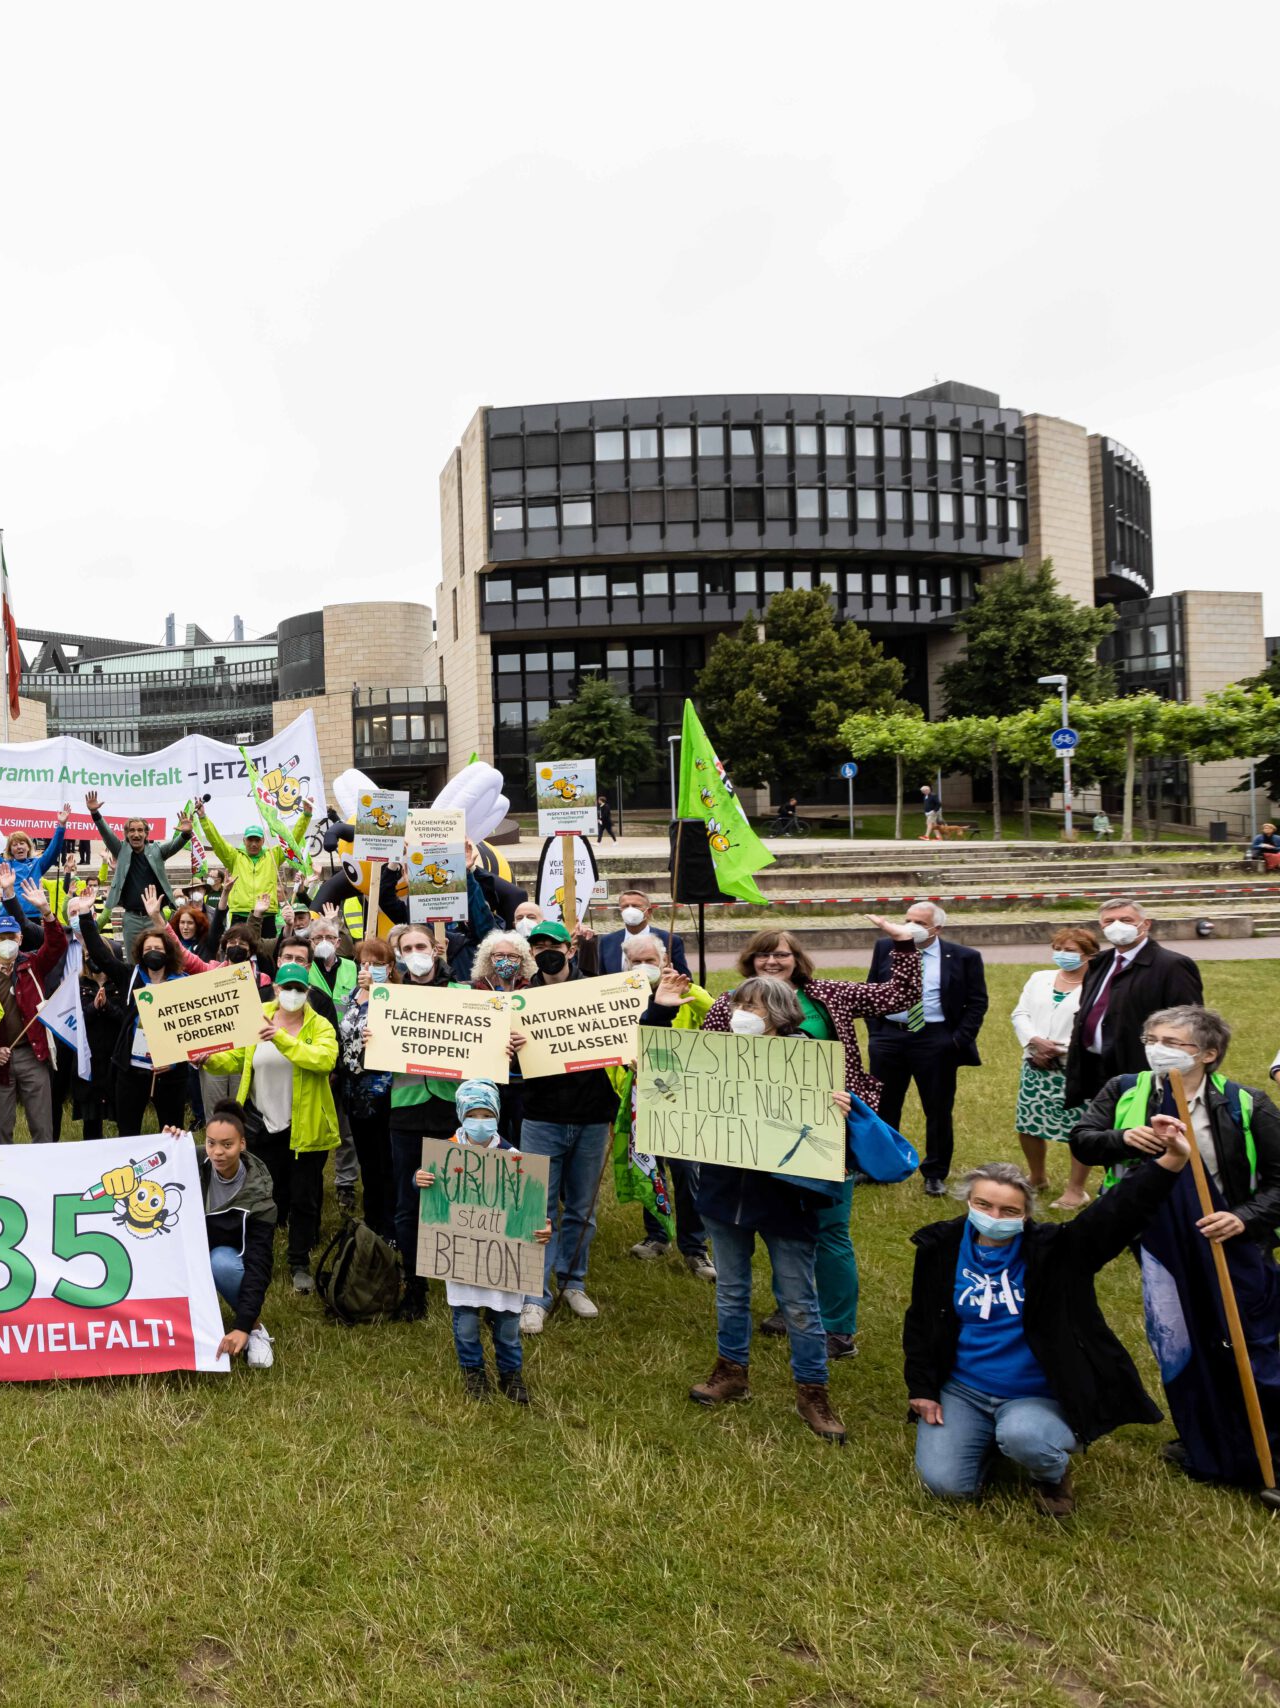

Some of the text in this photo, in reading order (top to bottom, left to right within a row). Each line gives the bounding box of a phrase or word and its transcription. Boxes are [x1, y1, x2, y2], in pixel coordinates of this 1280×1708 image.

[58, 765, 182, 788] Artenvielfalt
[203, 756, 267, 784] JETZT!
[157, 989, 240, 1018] ARTENSCHUTZ
[163, 1004, 240, 1031] IN DER STADT
[520, 997, 641, 1026] NATURNAHE UND
[384, 1008, 491, 1028] FLÄCHENFRASS
[530, 1014, 639, 1041] WILDE WÄLDER
[176, 1021, 236, 1044] FÖRDERN!
[391, 1025, 483, 1043] VERBINDLICH
[549, 1033, 629, 1054] ZULASSEN!
[401, 1042, 470, 1059] STOPPEN!
[640, 1028, 835, 1090] KURZSTRECKEN
[683, 1076, 839, 1127] FLÜGE NUR FÜR
[648, 1110, 758, 1166] INSEKTEN
[442, 1147, 522, 1212] GRÜN
[457, 1206, 502, 1234] statt
[434, 1231, 523, 1290] BETON
